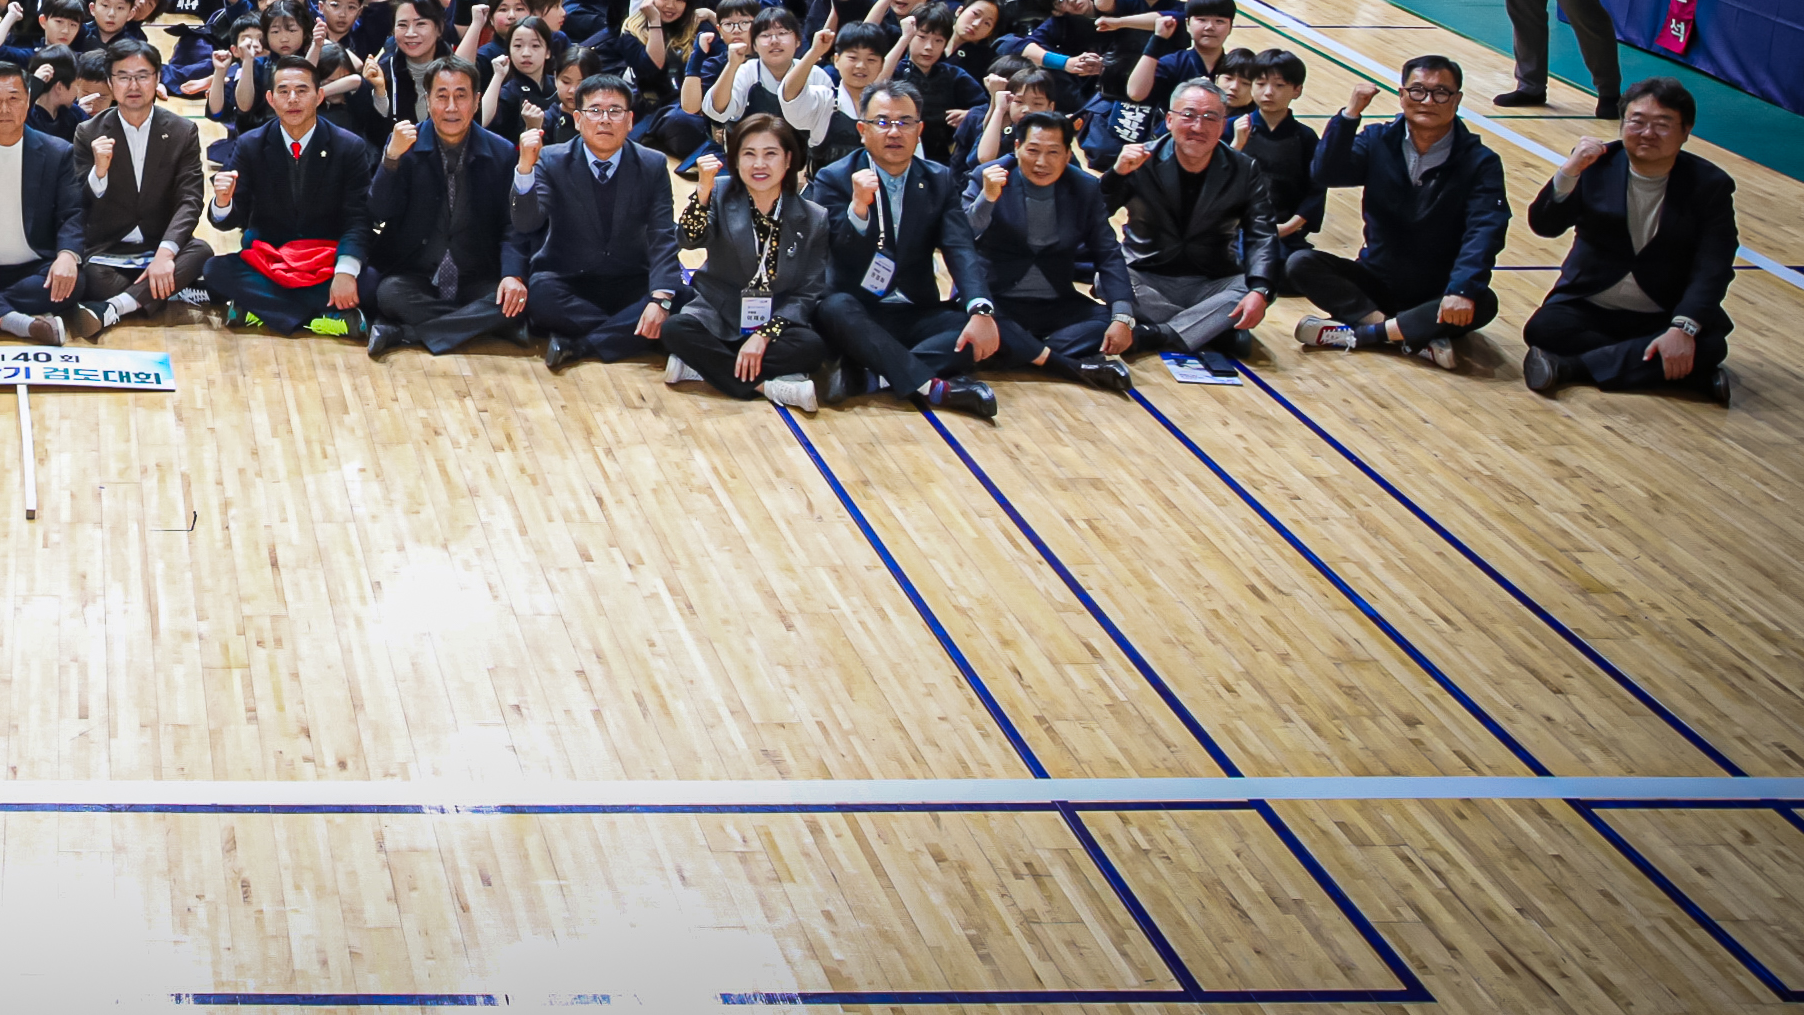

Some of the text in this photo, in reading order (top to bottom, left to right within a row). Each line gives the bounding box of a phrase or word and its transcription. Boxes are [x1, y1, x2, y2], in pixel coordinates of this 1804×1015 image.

[11, 352, 53, 363] 40
[60, 354, 80, 363] 회
[43, 366, 163, 385] 검도대회
